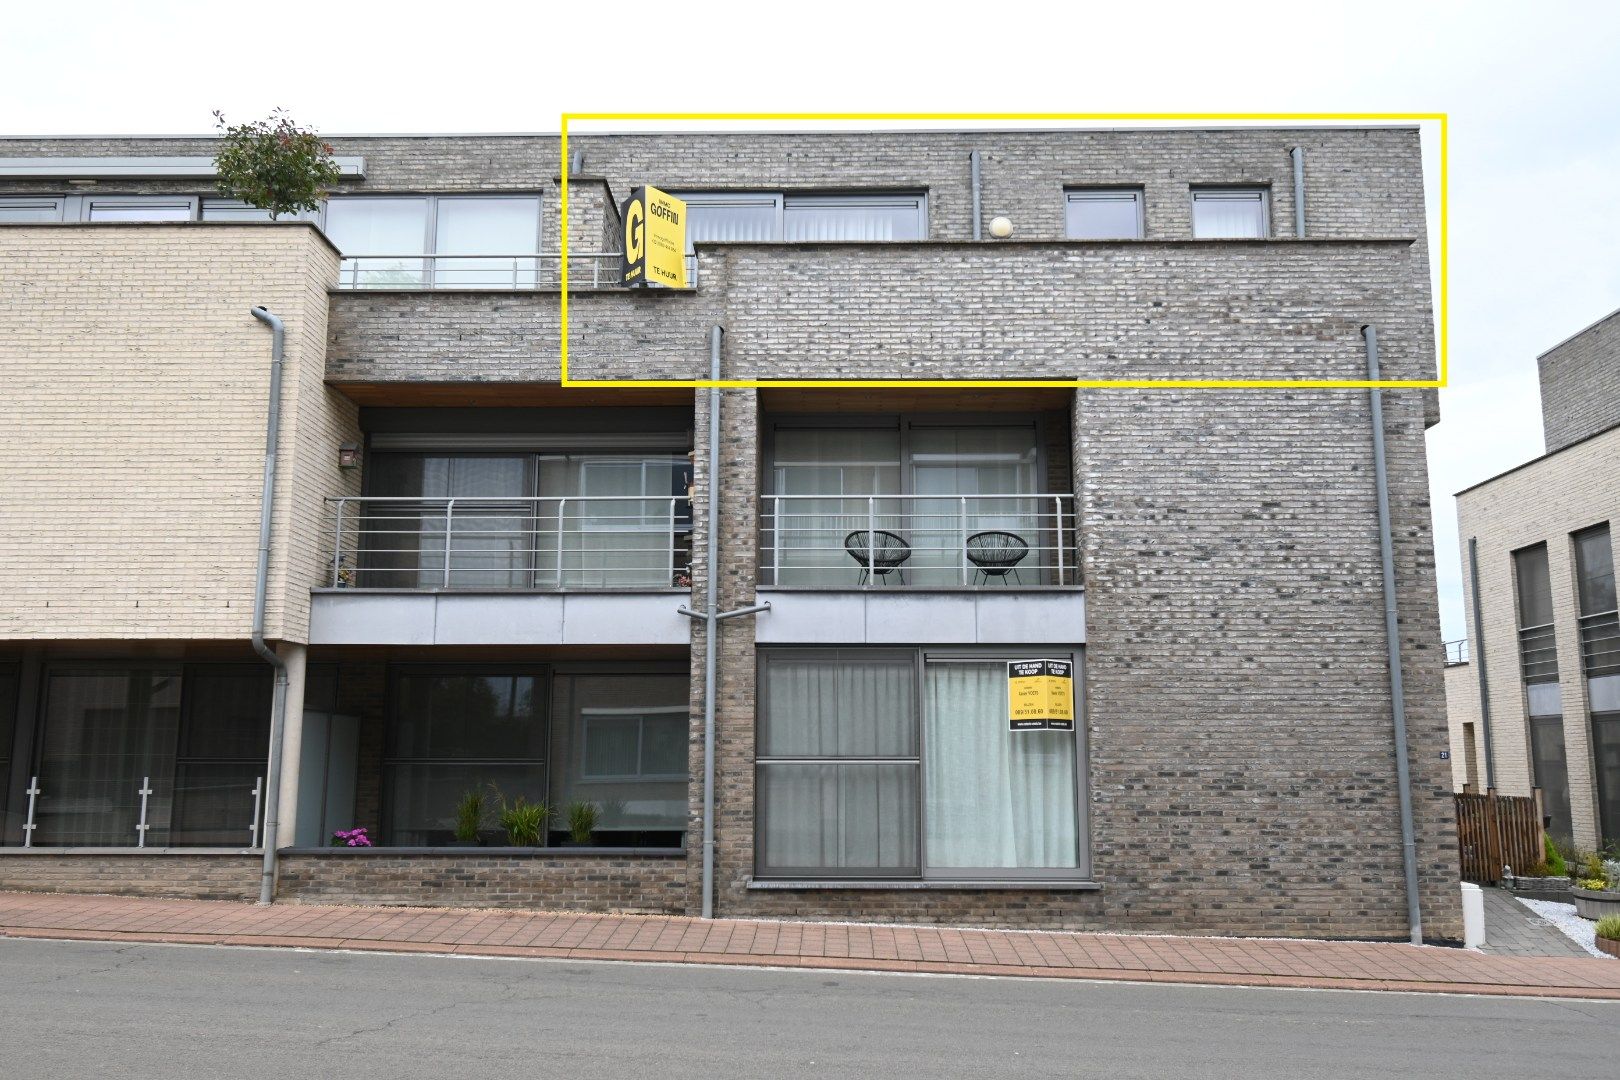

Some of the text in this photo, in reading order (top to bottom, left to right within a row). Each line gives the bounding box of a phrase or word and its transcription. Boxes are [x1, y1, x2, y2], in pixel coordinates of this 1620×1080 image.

[650, 202, 678, 225] GOFFIN
[626, 199, 644, 264] G
[653, 266, 678, 281] TE HUUR
